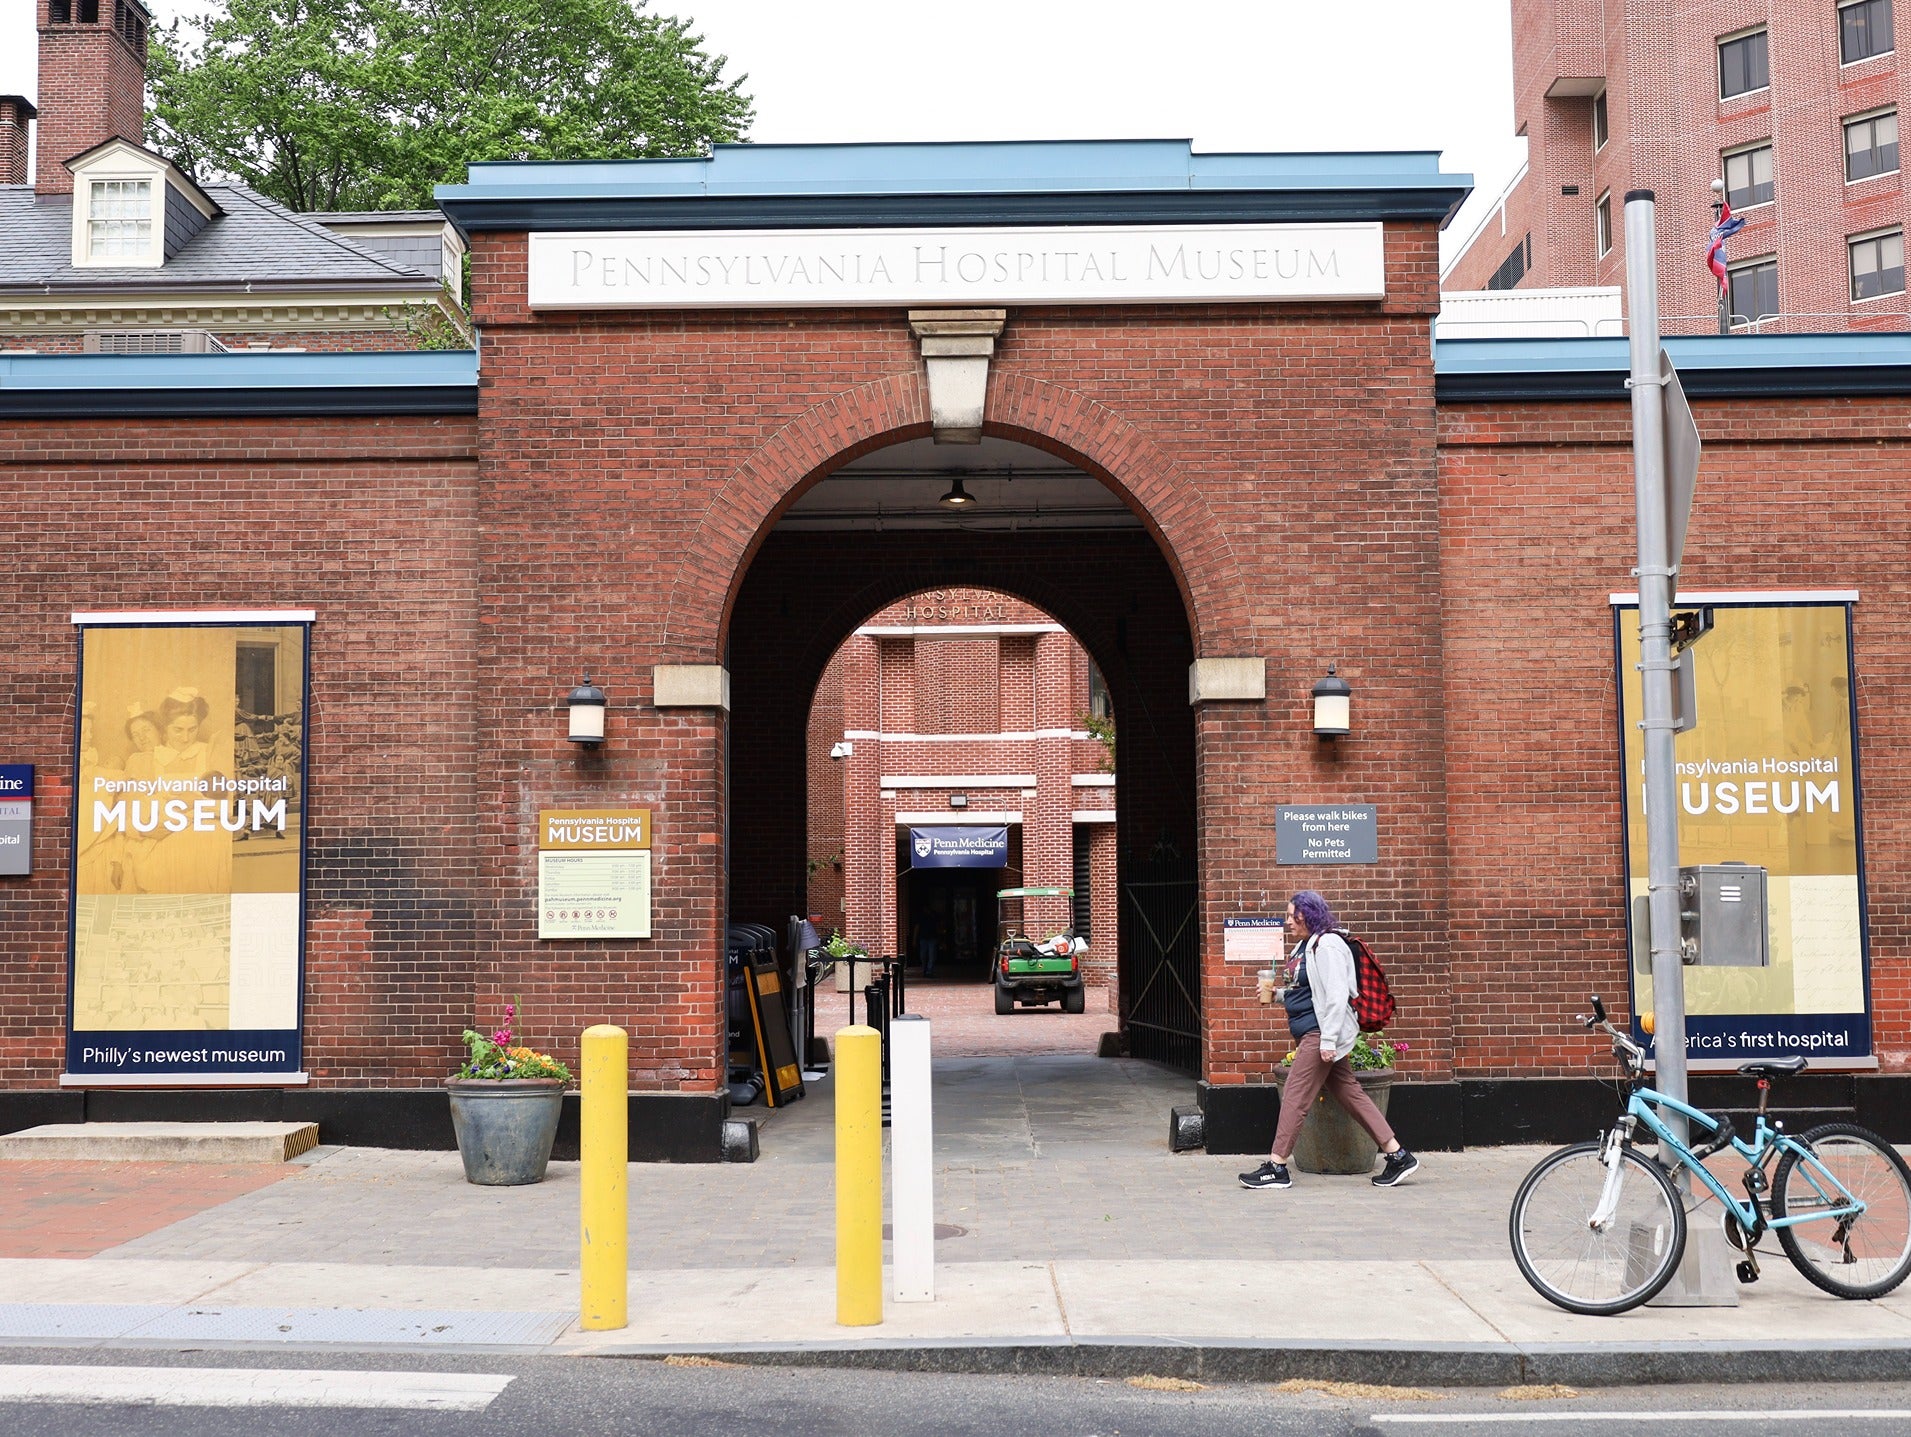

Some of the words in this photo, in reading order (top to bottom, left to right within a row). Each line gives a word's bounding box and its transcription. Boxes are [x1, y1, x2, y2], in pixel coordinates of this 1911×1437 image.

[571, 249, 893, 287] PENNSYLVANIA
[914, 246, 1128, 283] HOSPITAL
[1145, 243, 1340, 281] MUSEUM
[906, 605, 1006, 619] HOSPITAL
[1641, 758, 1758, 779] nsylvania
[1763, 756, 1839, 777] Hospital
[93, 776, 209, 796] Pennsylvania
[212, 775, 287, 794] Hospital
[1642, 780, 1840, 815] USEUM
[92, 799, 286, 833] MUSEUM
[548, 817, 604, 826] Pennsylvania
[606, 816, 641, 825] Hospital
[1284, 811, 1315, 821] Please
[1316, 811, 1340, 821] walk
[1341, 810, 1368, 820] bikes
[548, 826, 641, 843] MUSEUM
[1302, 822, 1326, 832] from
[1328, 822, 1350, 831] here
[933, 838, 958, 848] Penn
[959, 837, 1005, 848] Medicine
[1308, 838, 1322, 847] No
[1324, 838, 1345, 847] Pets
[1302, 848, 1351, 858] Permitted
[1234, 919, 1251, 927] Penn
[1251, 918, 1281, 927] Medicine
[1650, 1031, 1737, 1049] erica's
[1739, 1031, 1774, 1048] first
[1777, 1030, 1849, 1050] hospital
[83, 1046, 141, 1067] Philly's
[144, 1048, 208, 1063] newest
[211, 1049, 286, 1063] museum
